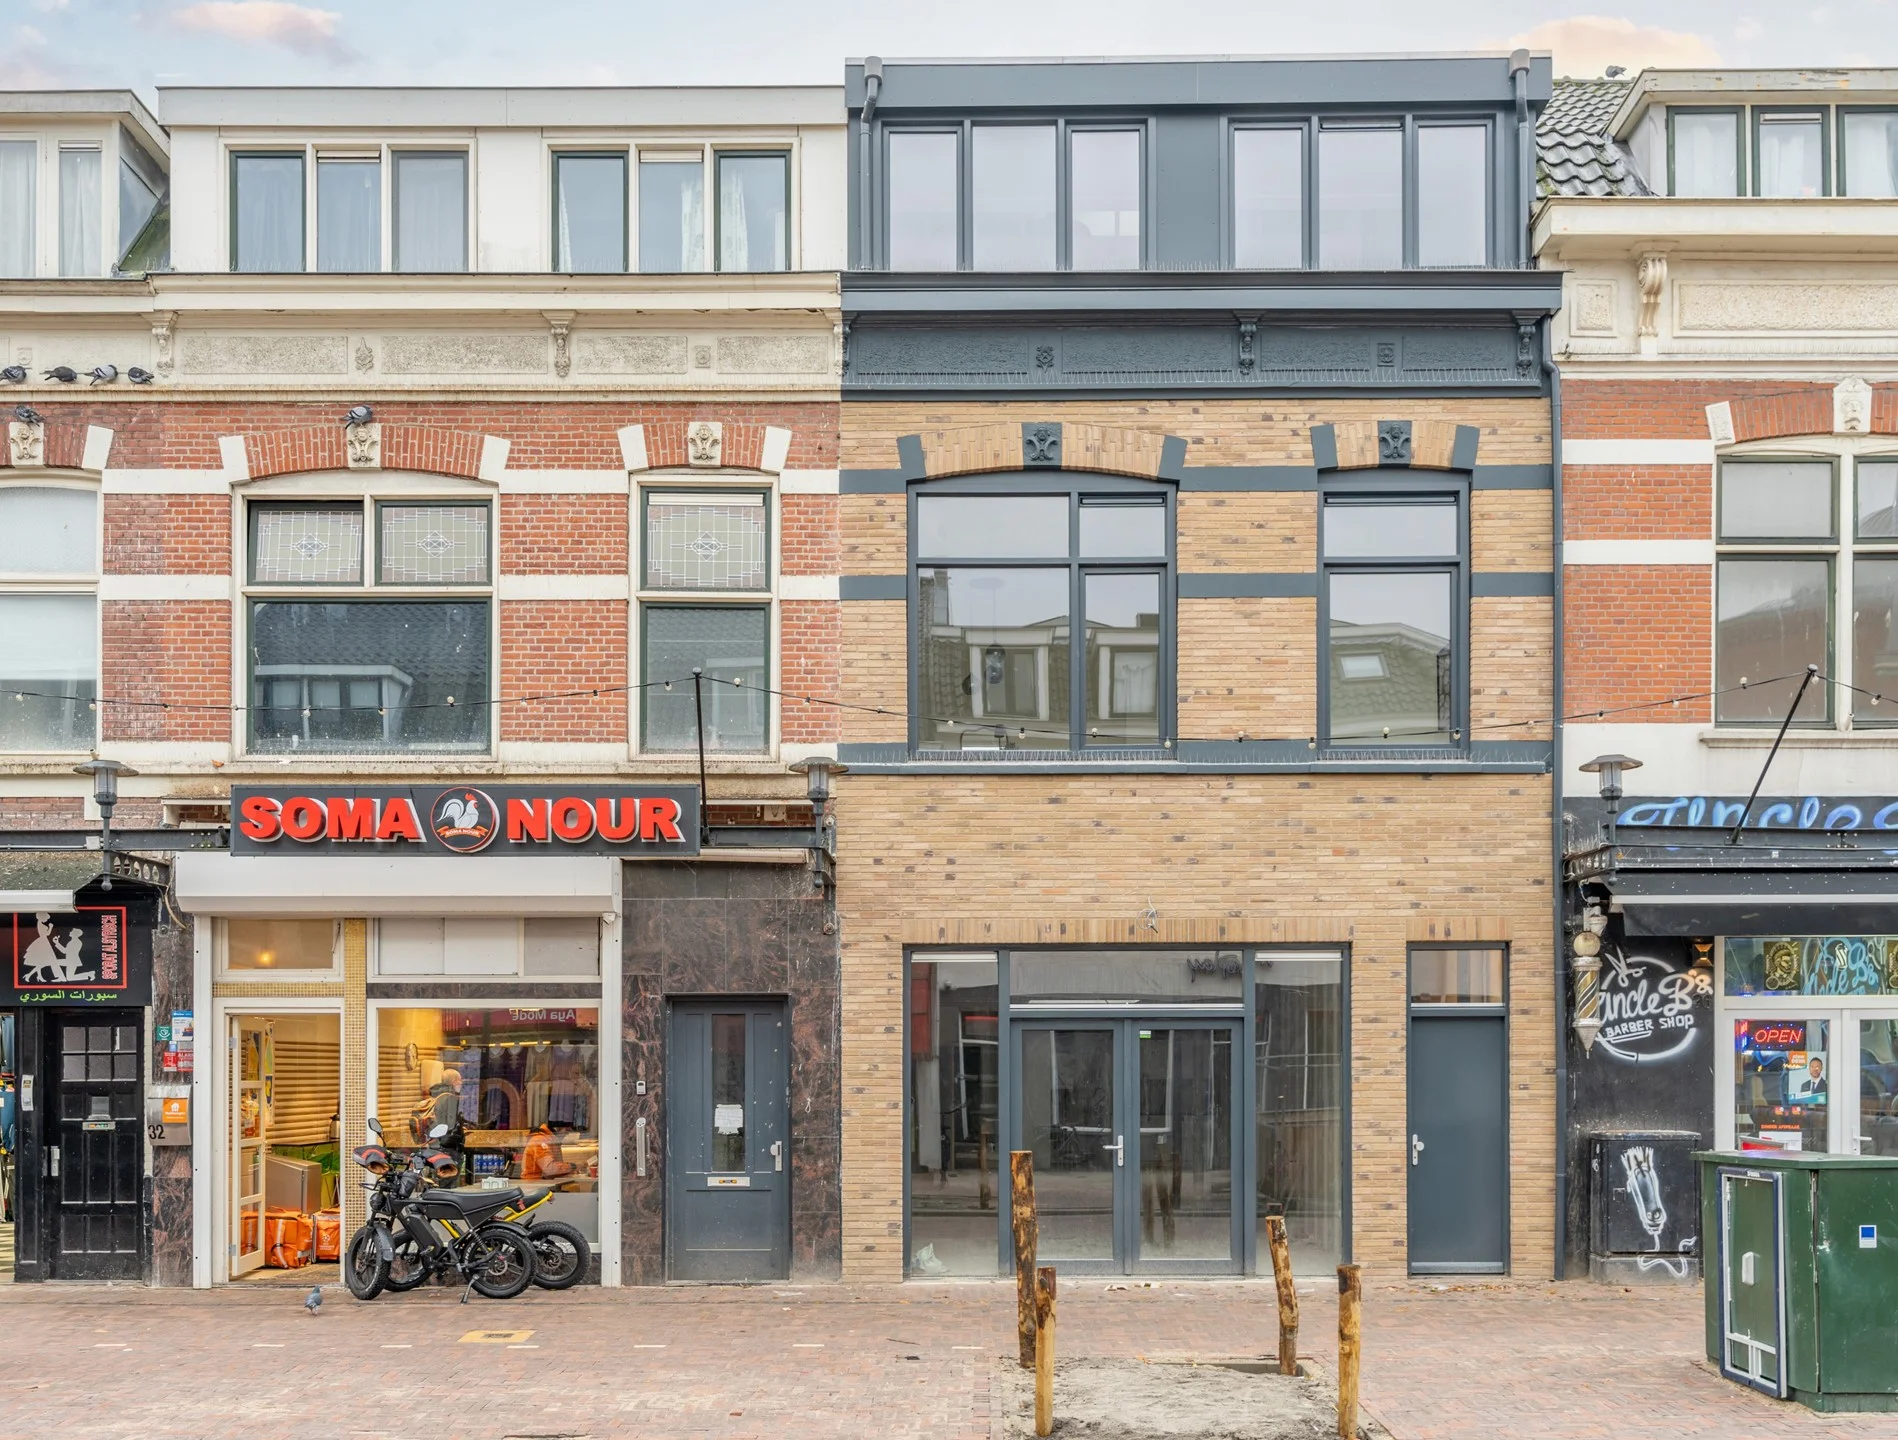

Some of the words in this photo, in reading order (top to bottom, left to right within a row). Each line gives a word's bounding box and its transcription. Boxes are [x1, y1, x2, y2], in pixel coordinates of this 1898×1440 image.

[239, 796, 426, 842] SOMA
[507, 797, 685, 842] NOUR
[19, 990, 65, 1002] السوري
[1605, 1019, 1654, 1038] BARBER
[1659, 1014, 1694, 1029] SHOP
[1755, 1029, 1802, 1043] OPEN
[148, 1124, 165, 1140] 32
